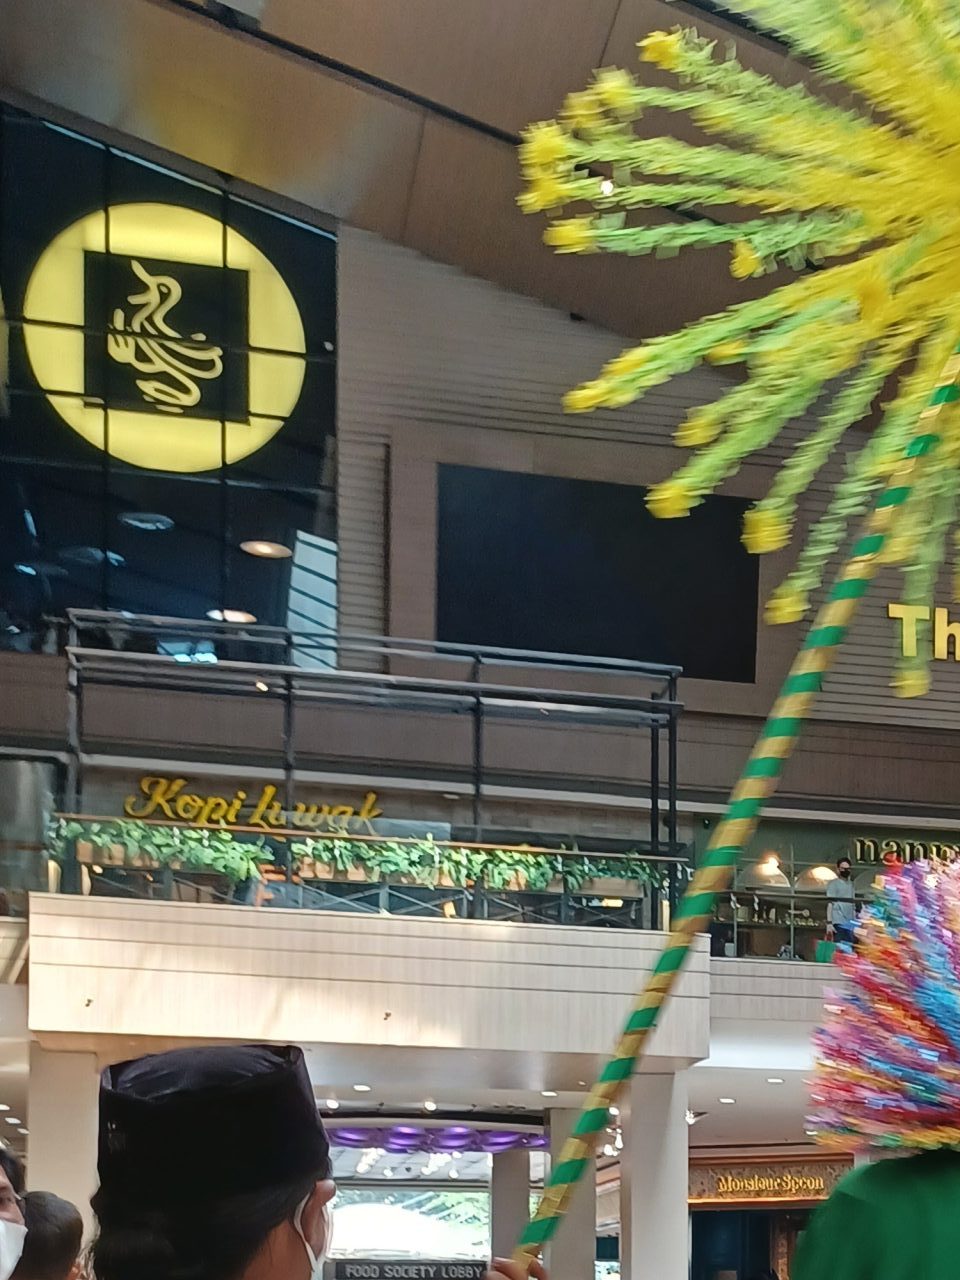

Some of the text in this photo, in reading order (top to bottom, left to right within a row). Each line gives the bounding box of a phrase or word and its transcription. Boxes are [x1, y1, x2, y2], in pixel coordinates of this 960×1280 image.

[124, 777, 385, 838] Kopi Luwak
[718, 1174, 824, 1193] Monsieur Spoon
[345, 1264, 482, 1278] FOOD SOCIETY LOBBY
